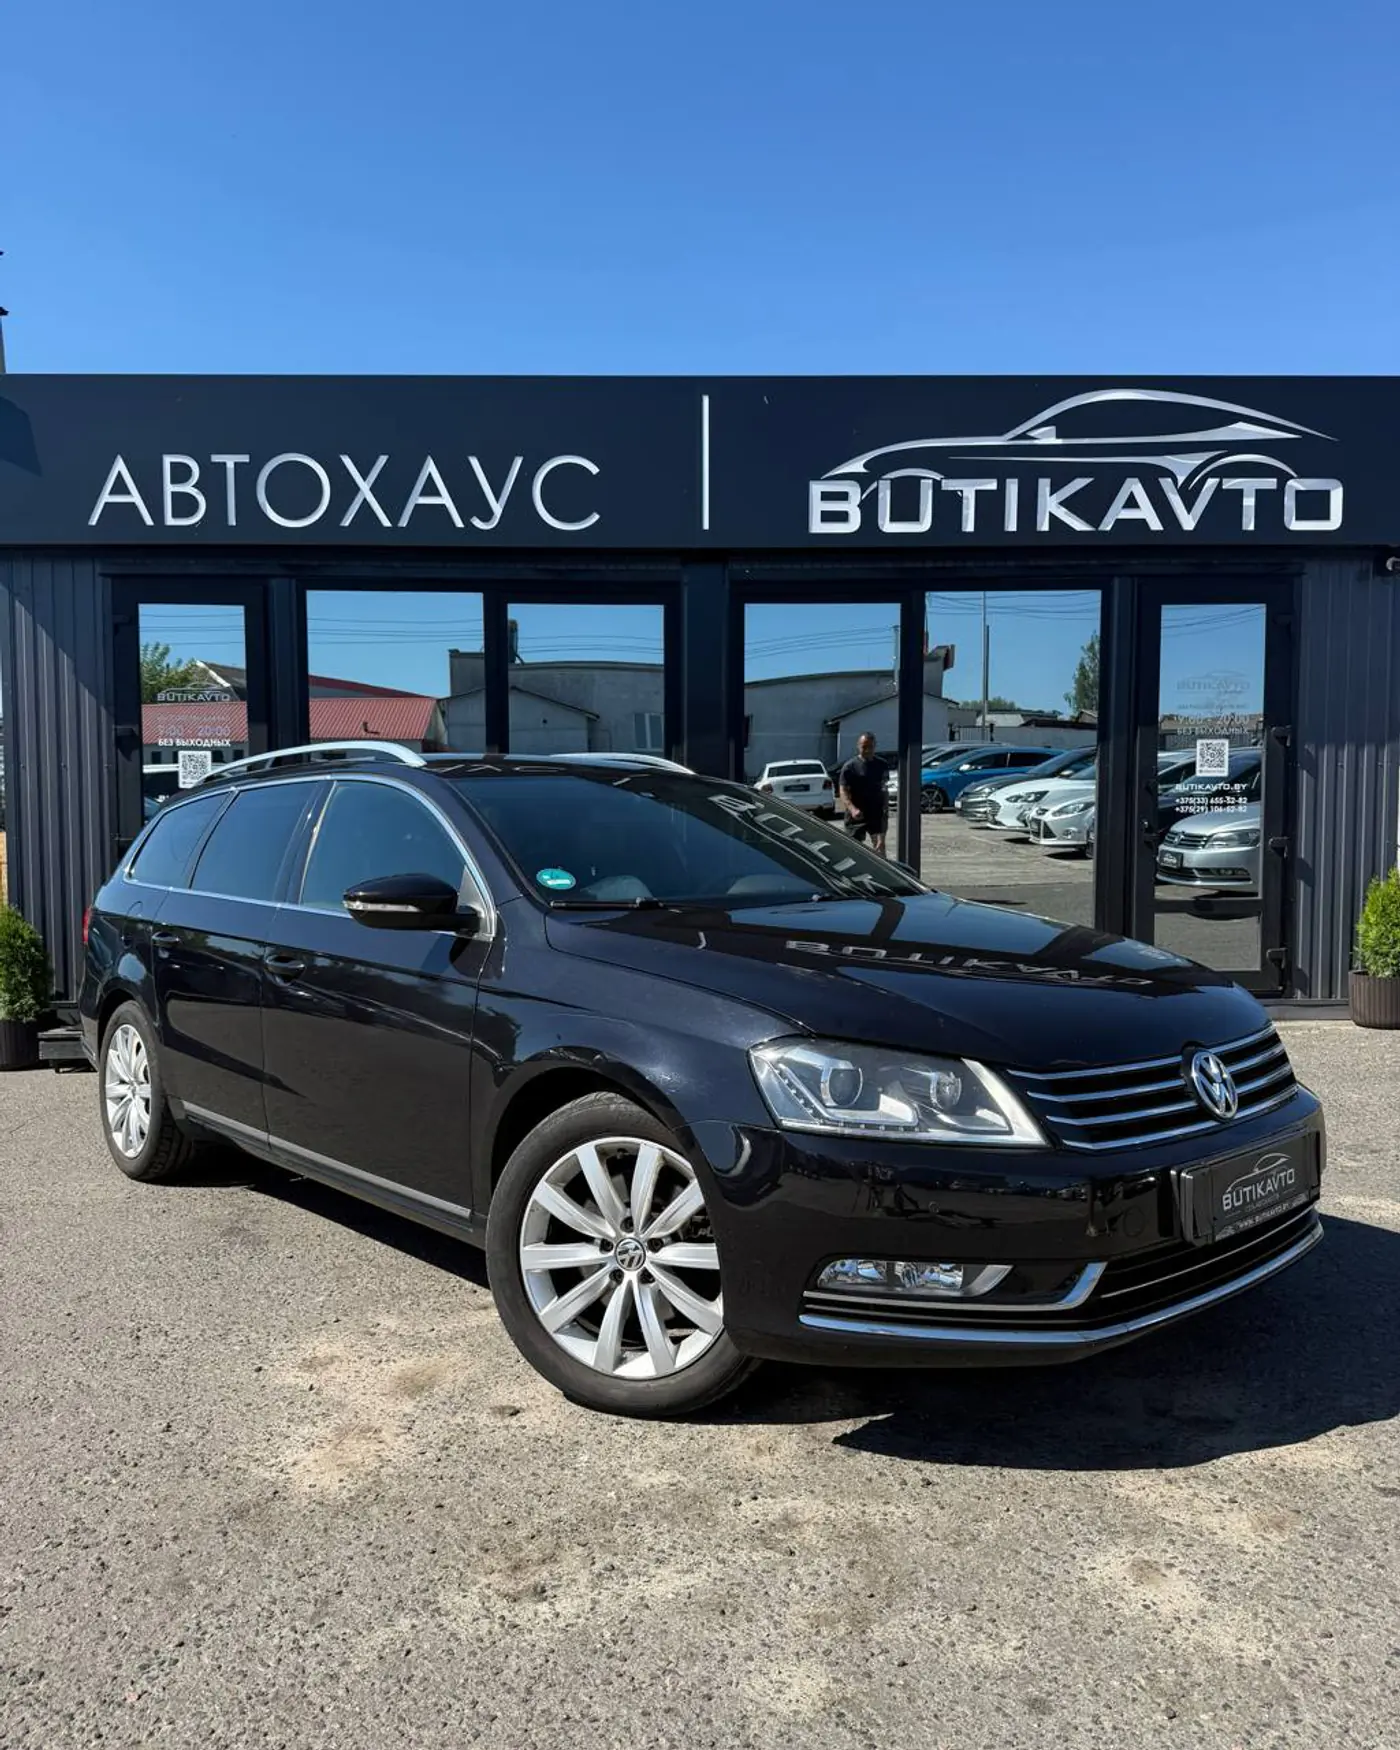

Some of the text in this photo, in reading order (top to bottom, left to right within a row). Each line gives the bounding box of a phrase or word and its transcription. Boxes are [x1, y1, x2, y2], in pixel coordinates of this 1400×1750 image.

[87, 453, 601, 531] АВТОХАУС
[808, 477, 1343, 534] BUTIKAVTO
[157, 692, 231, 702] BUTIKAVTO
[158, 738, 231, 748] БЕЗ ВЫХОДНЫХ
[1175, 783, 1248, 791] BUTIKAVTO.BY
[1222, 1167, 1296, 1212] BUTIKAVTO
